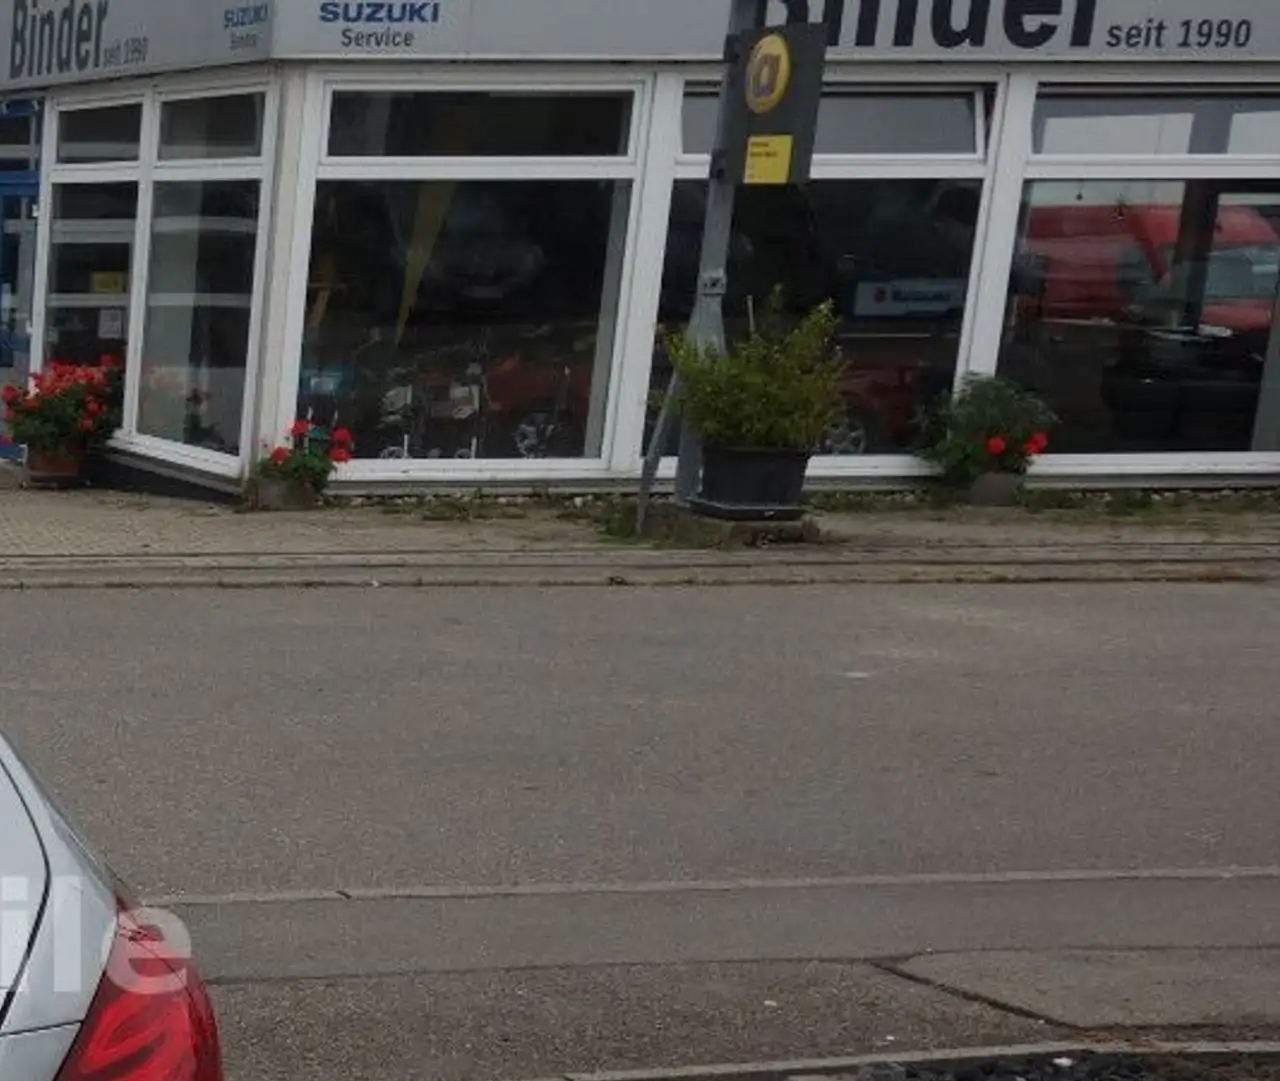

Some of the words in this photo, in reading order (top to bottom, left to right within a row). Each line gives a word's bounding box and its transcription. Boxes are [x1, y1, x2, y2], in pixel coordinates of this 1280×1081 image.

[224, 4, 269, 28] SUZUKI
[319, 1, 440, 23] SUZUKI
[10, 0, 109, 79] Binder
[341, 26, 414, 47] Service
[1106, 18, 1166, 48] seit
[1177, 18, 1251, 48] 1990
